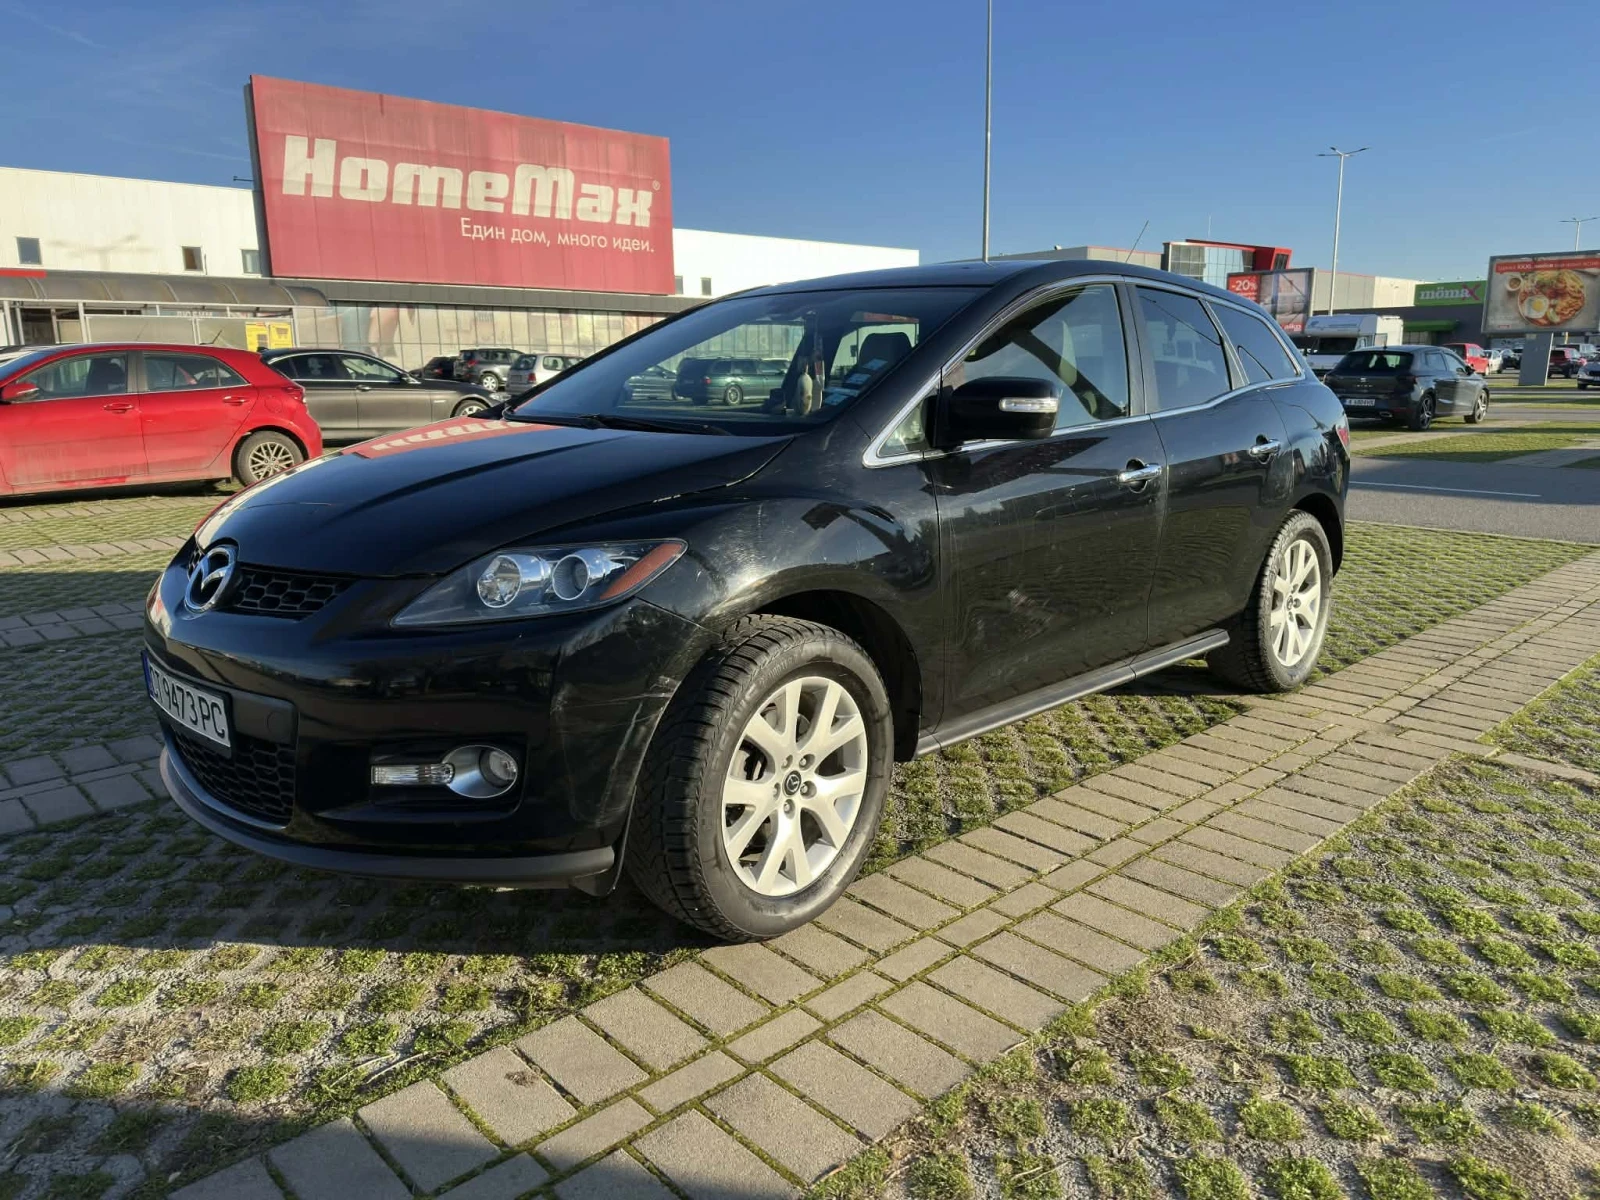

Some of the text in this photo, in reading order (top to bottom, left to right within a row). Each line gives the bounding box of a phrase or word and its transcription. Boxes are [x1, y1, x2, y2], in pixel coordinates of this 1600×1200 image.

[282, 135, 653, 227] HomeMax
[460, 217, 654, 252] Един дом, много идеи.
[1231, 279, 1258, 292] -20%
